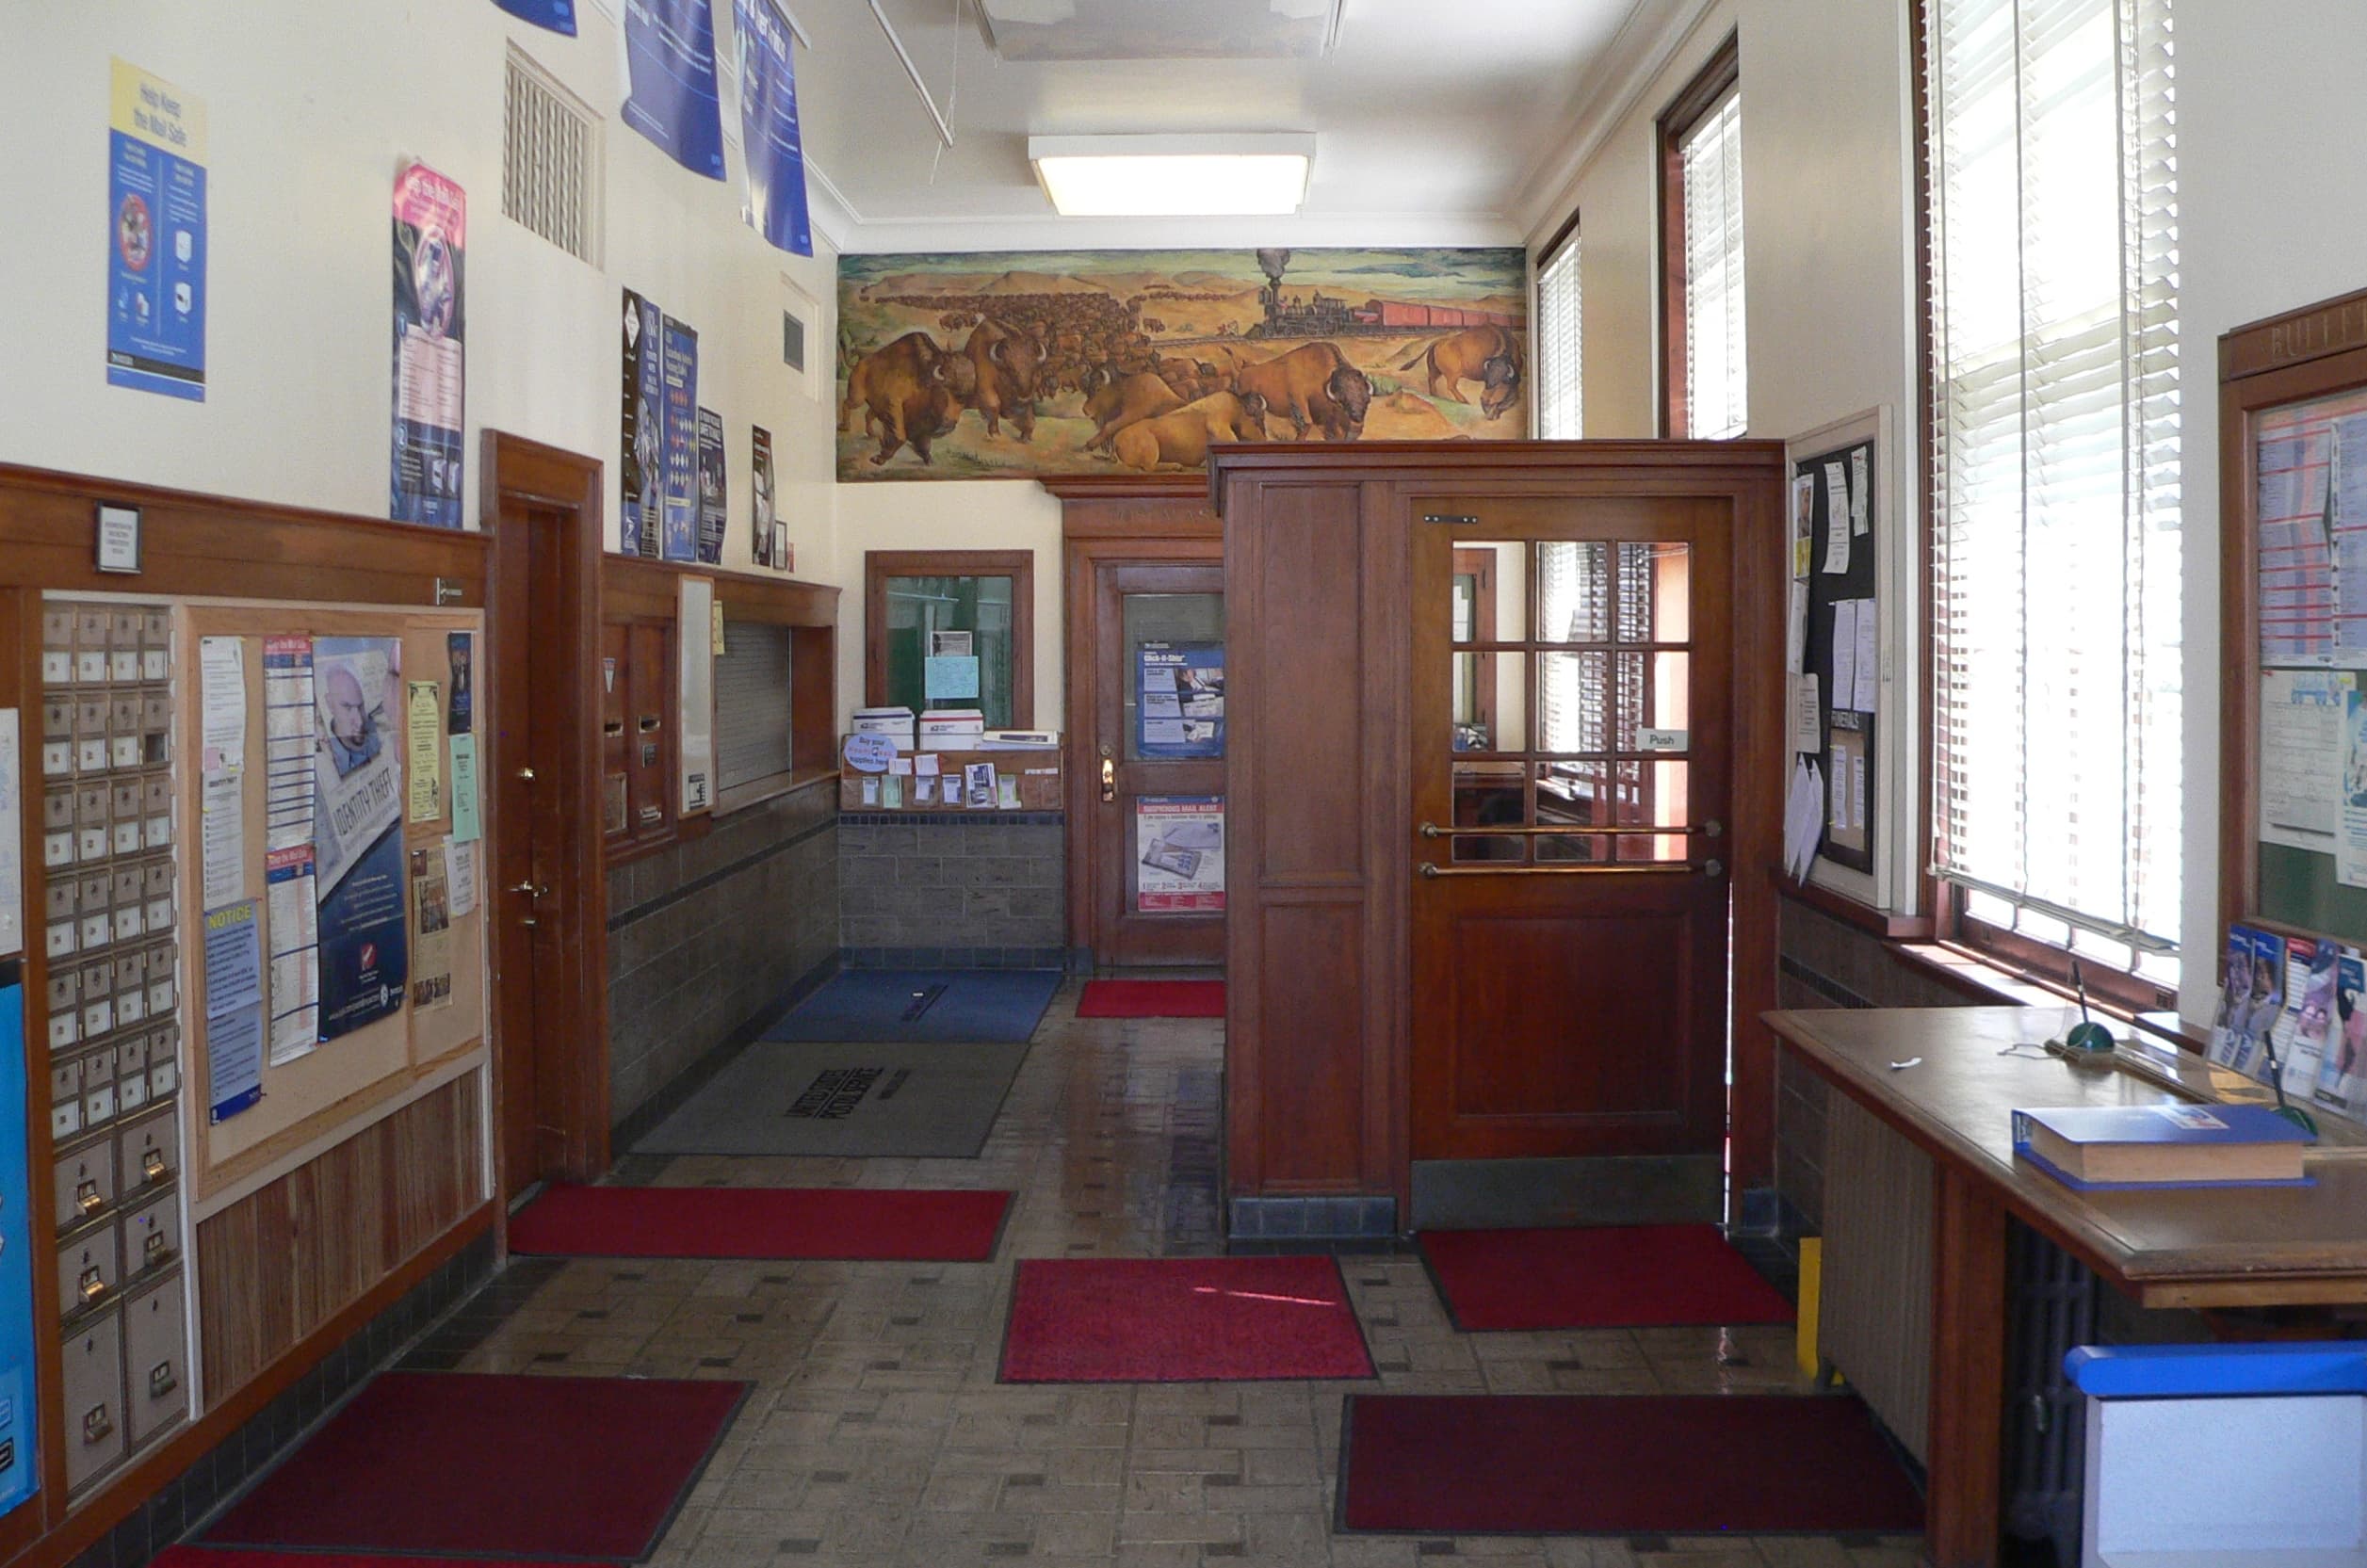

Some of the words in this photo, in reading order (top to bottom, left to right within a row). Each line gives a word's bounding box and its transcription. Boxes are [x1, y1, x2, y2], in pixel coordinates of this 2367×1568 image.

[139, 82, 159, 108] Help
[161, 91, 182, 120] Keep
[134, 107, 148, 130] the
[149, 113, 167, 138] Mail
[168, 121, 186, 148] Safe
[1649, 734, 1675, 745] Push
[332, 784, 371, 836] IDENTITY
[368, 768, 395, 807] THEFT
[1198, 803, 1218, 812] ALERT
[208, 904, 252, 931] NOTICE
